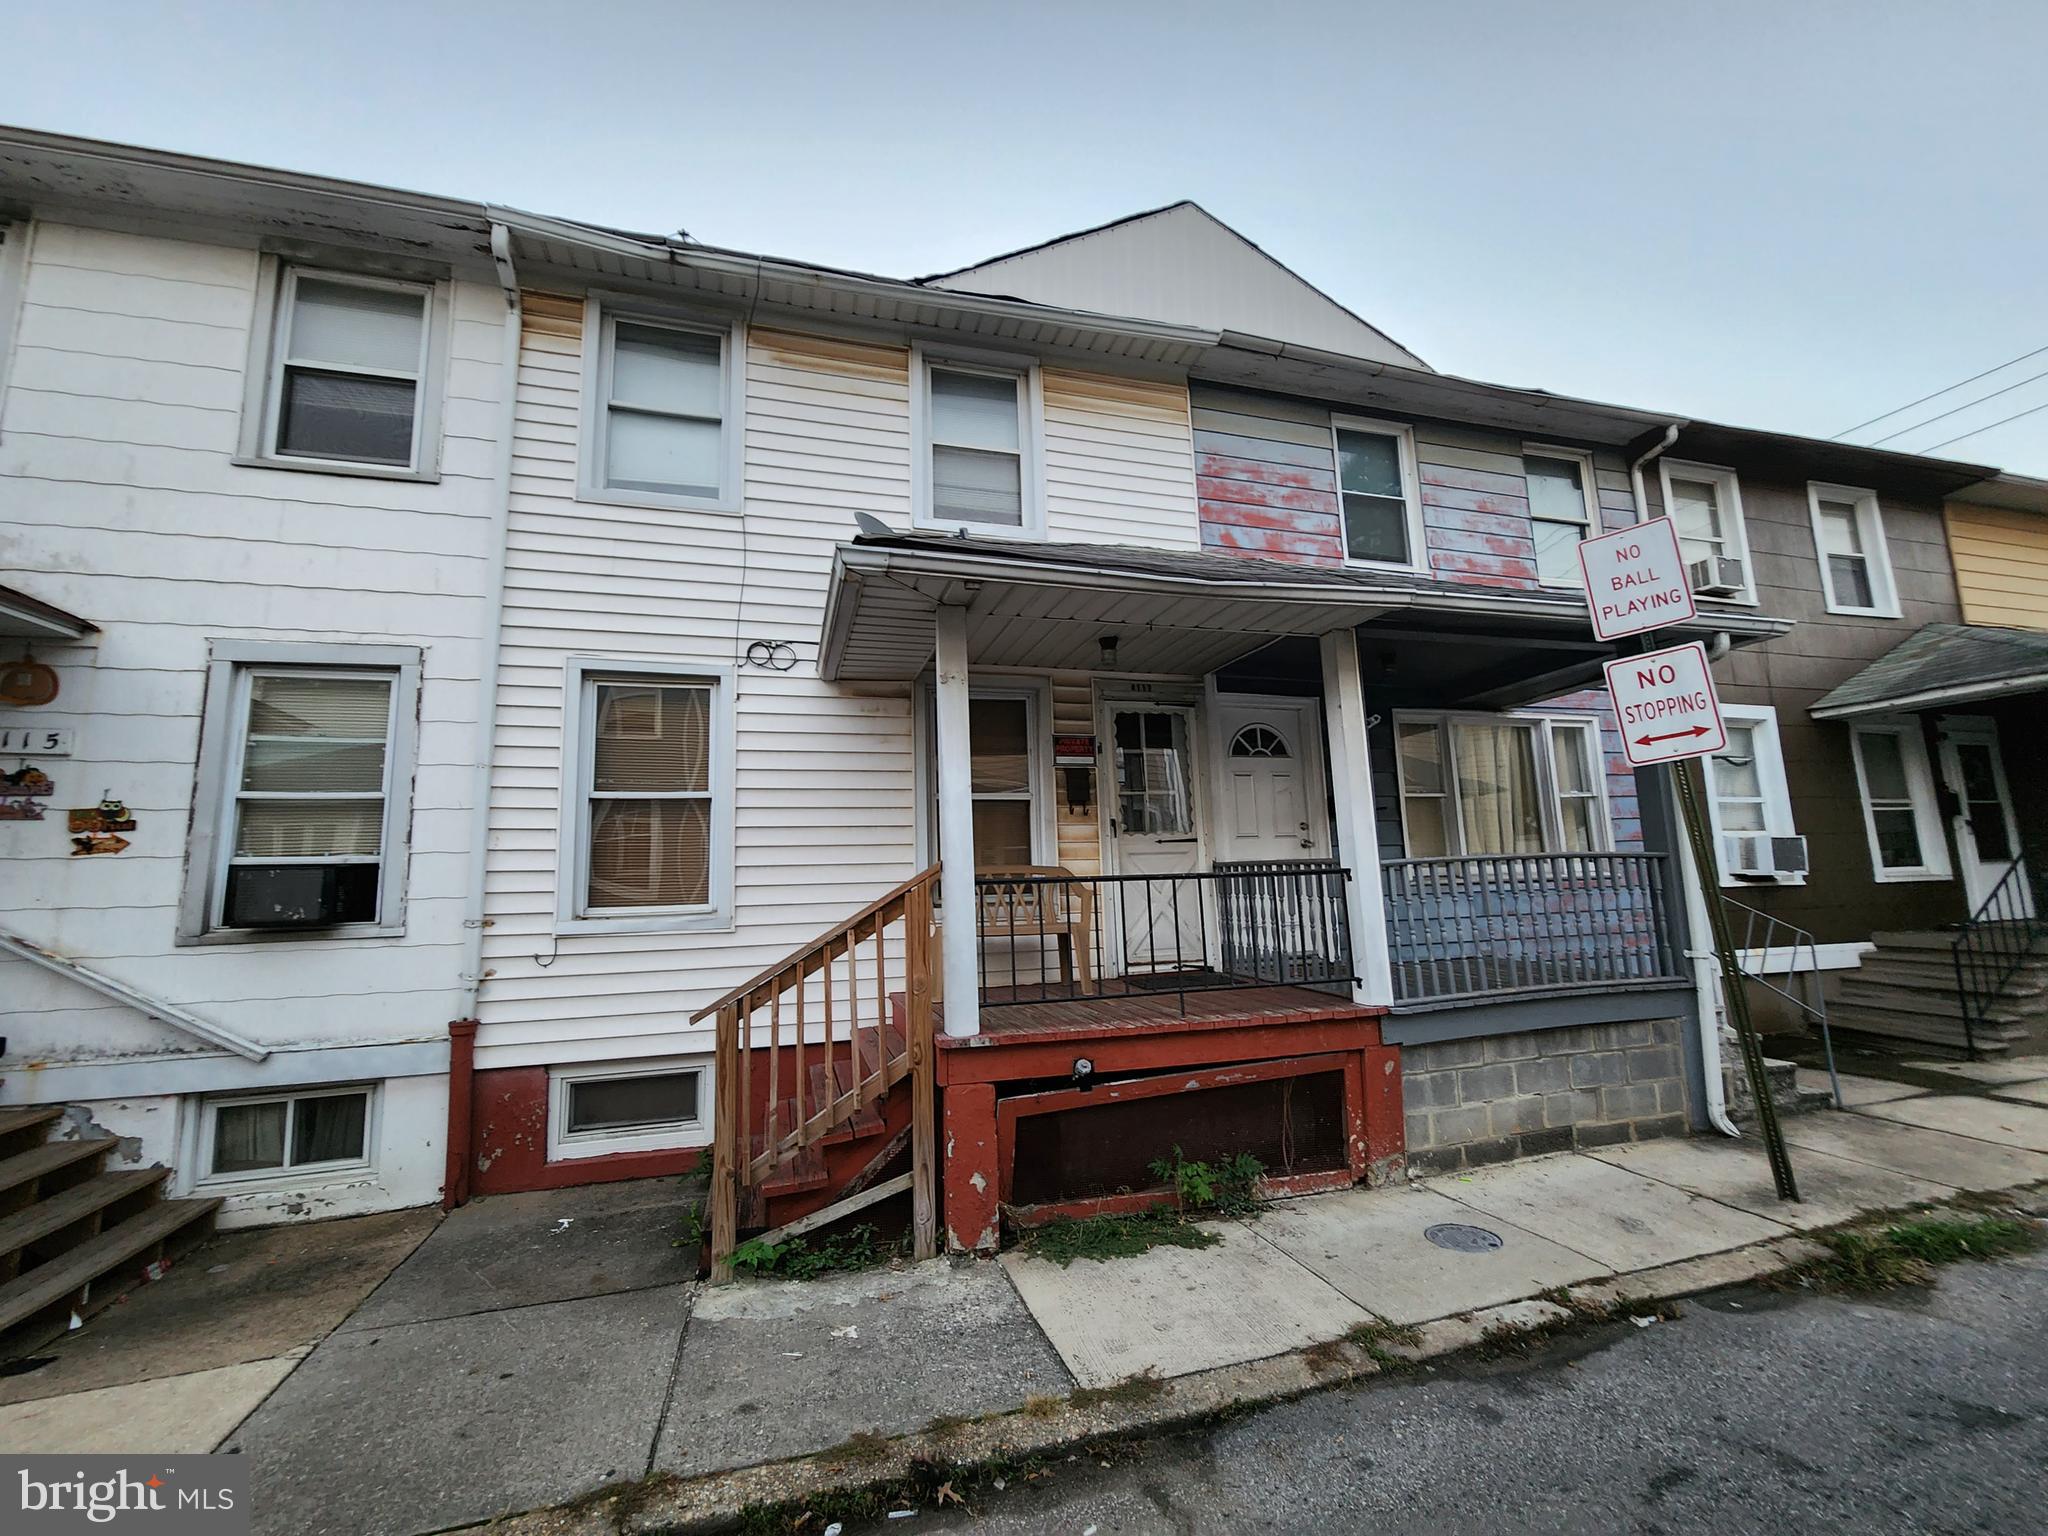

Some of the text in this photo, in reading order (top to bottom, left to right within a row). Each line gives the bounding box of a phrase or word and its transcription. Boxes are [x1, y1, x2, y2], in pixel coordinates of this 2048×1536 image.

[1616, 544, 1641, 563] NO
[1611, 568, 1661, 591] BALL
[1602, 588, 1682, 620] PLAYING
[1636, 665, 1676, 689] NO
[1625, 692, 1707, 724] STOPPING
